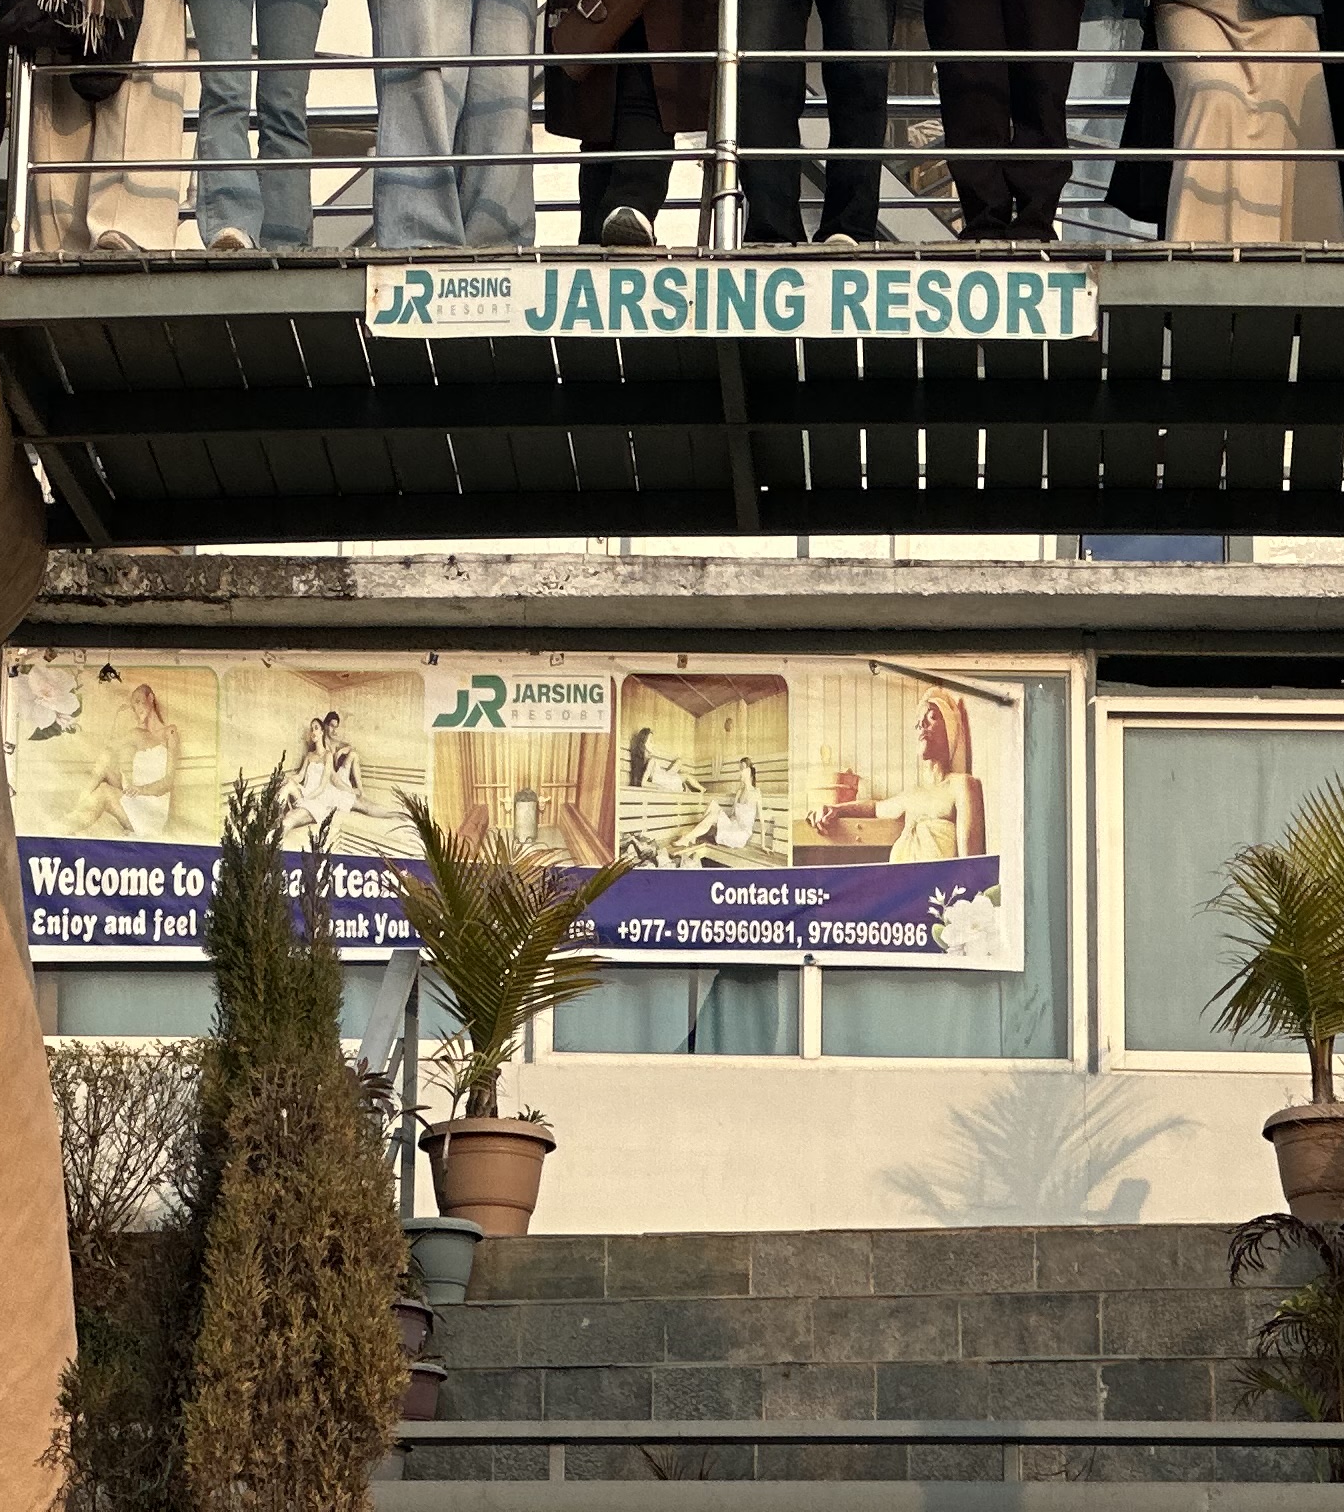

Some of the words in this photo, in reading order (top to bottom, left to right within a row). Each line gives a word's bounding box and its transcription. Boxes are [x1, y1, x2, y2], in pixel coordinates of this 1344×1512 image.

[437, 277, 512, 299] JARSING
[525, 266, 806, 334] JARSING
[830, 268, 1088, 335] RESORT
[437, 303, 512, 316] RESORT
[512, 683, 605, 704] JARSING
[28, 856, 165, 896] Welcome
[172, 862, 205, 897] to
[711, 882, 789, 905] Contact
[32, 908, 98, 943] Enjoy
[104, 910, 147, 936] and
[153, 908, 198, 943] feel
[374, 913, 411, 945] You
[617, 919, 672, 943] +977-
[677, 919, 804, 949] 9765960981,
[808, 920, 928, 947] 9765960986
